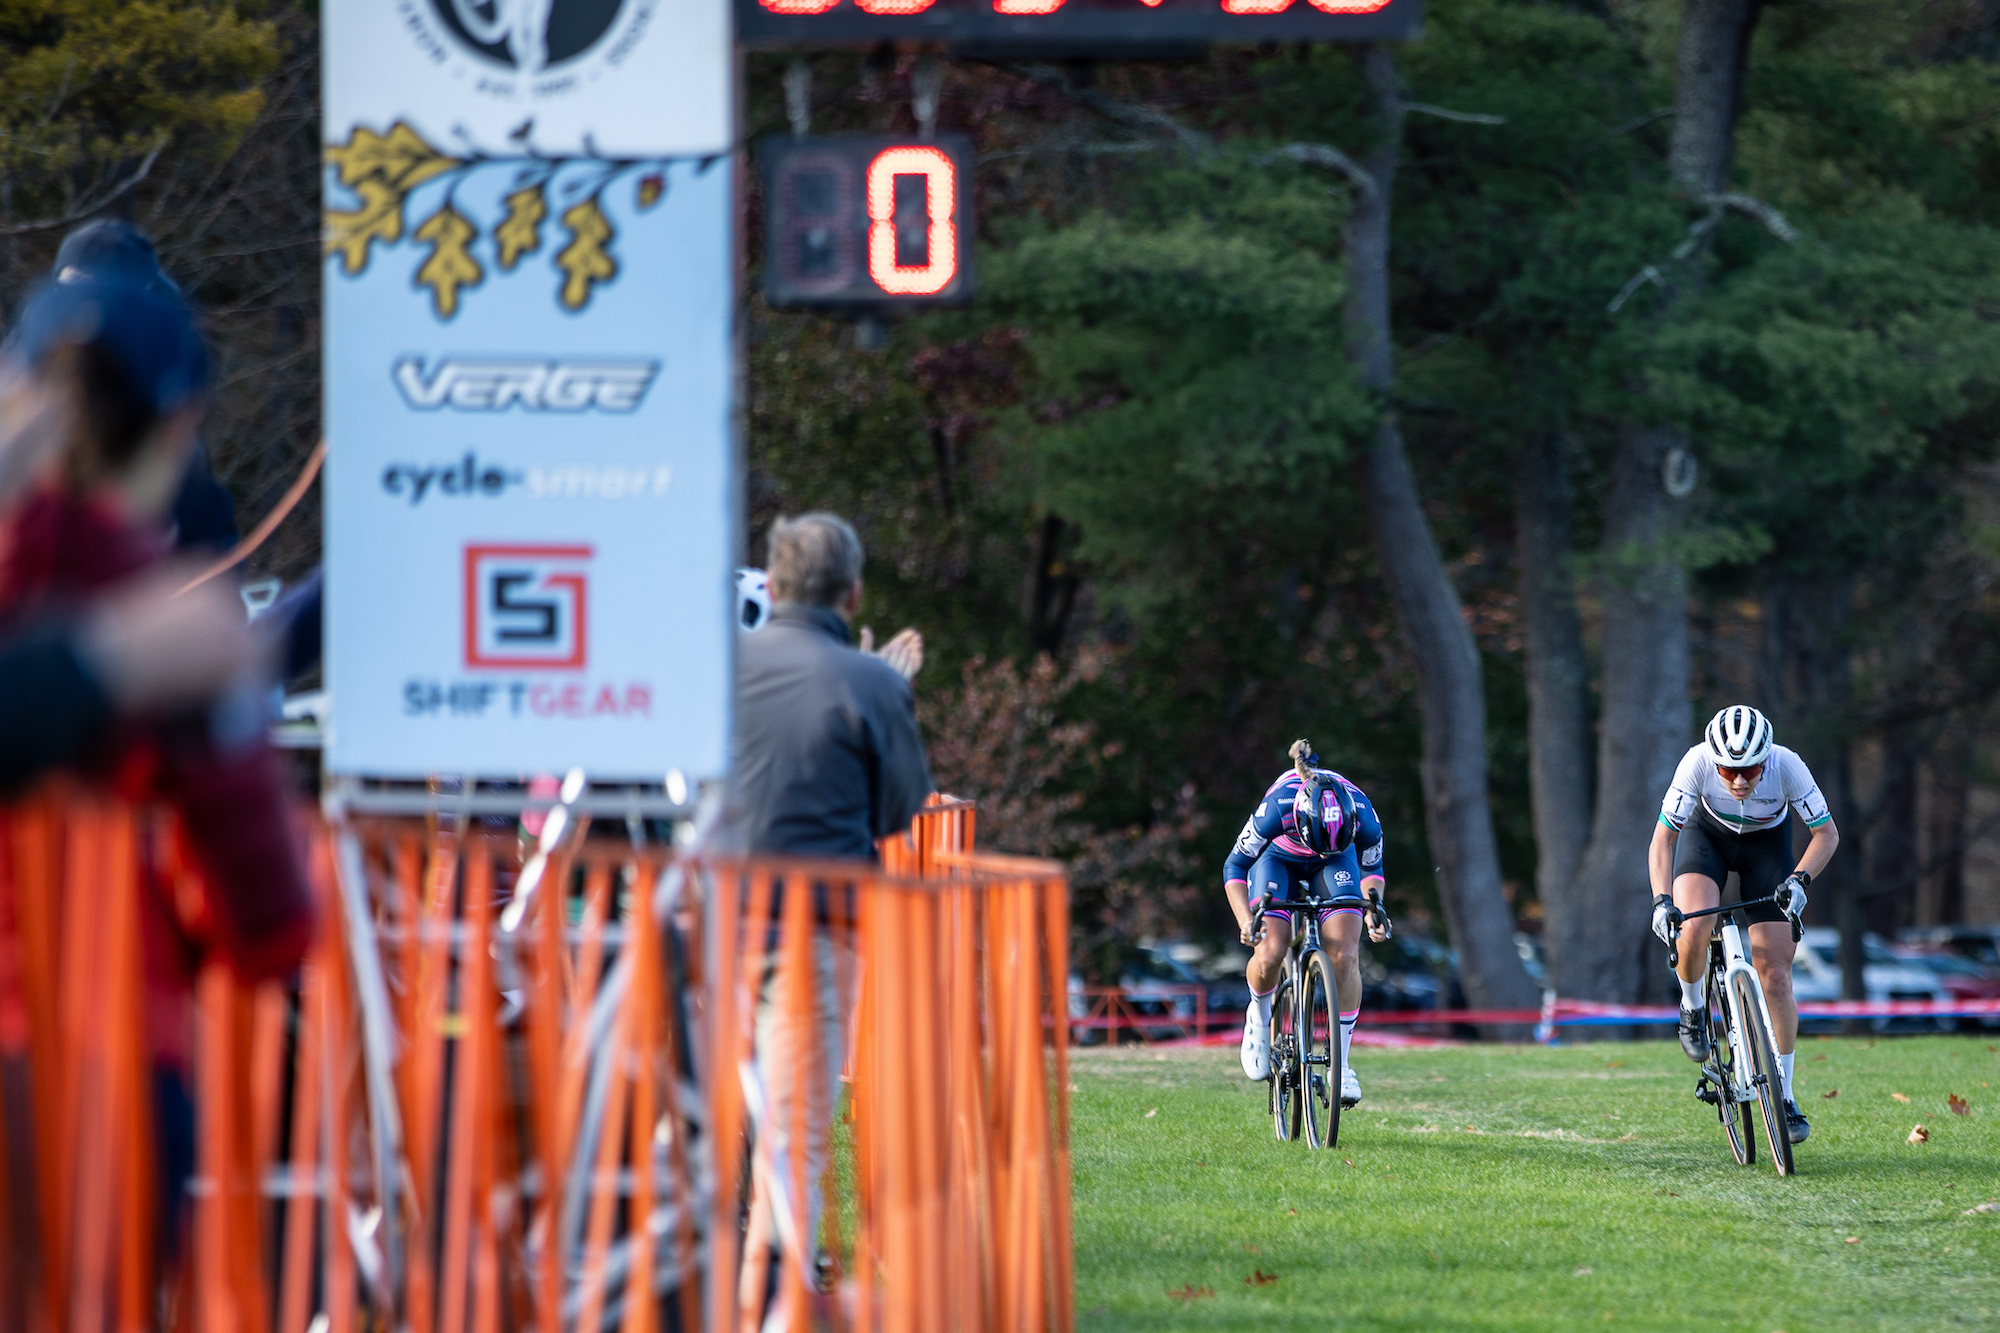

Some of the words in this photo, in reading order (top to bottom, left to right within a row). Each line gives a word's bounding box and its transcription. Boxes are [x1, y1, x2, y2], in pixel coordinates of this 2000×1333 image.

[867, 146, 957, 295] 0
[1676, 794, 1683, 814] 1
[1802, 800, 1814, 817] 1
[1240, 829, 1252, 846] 2
